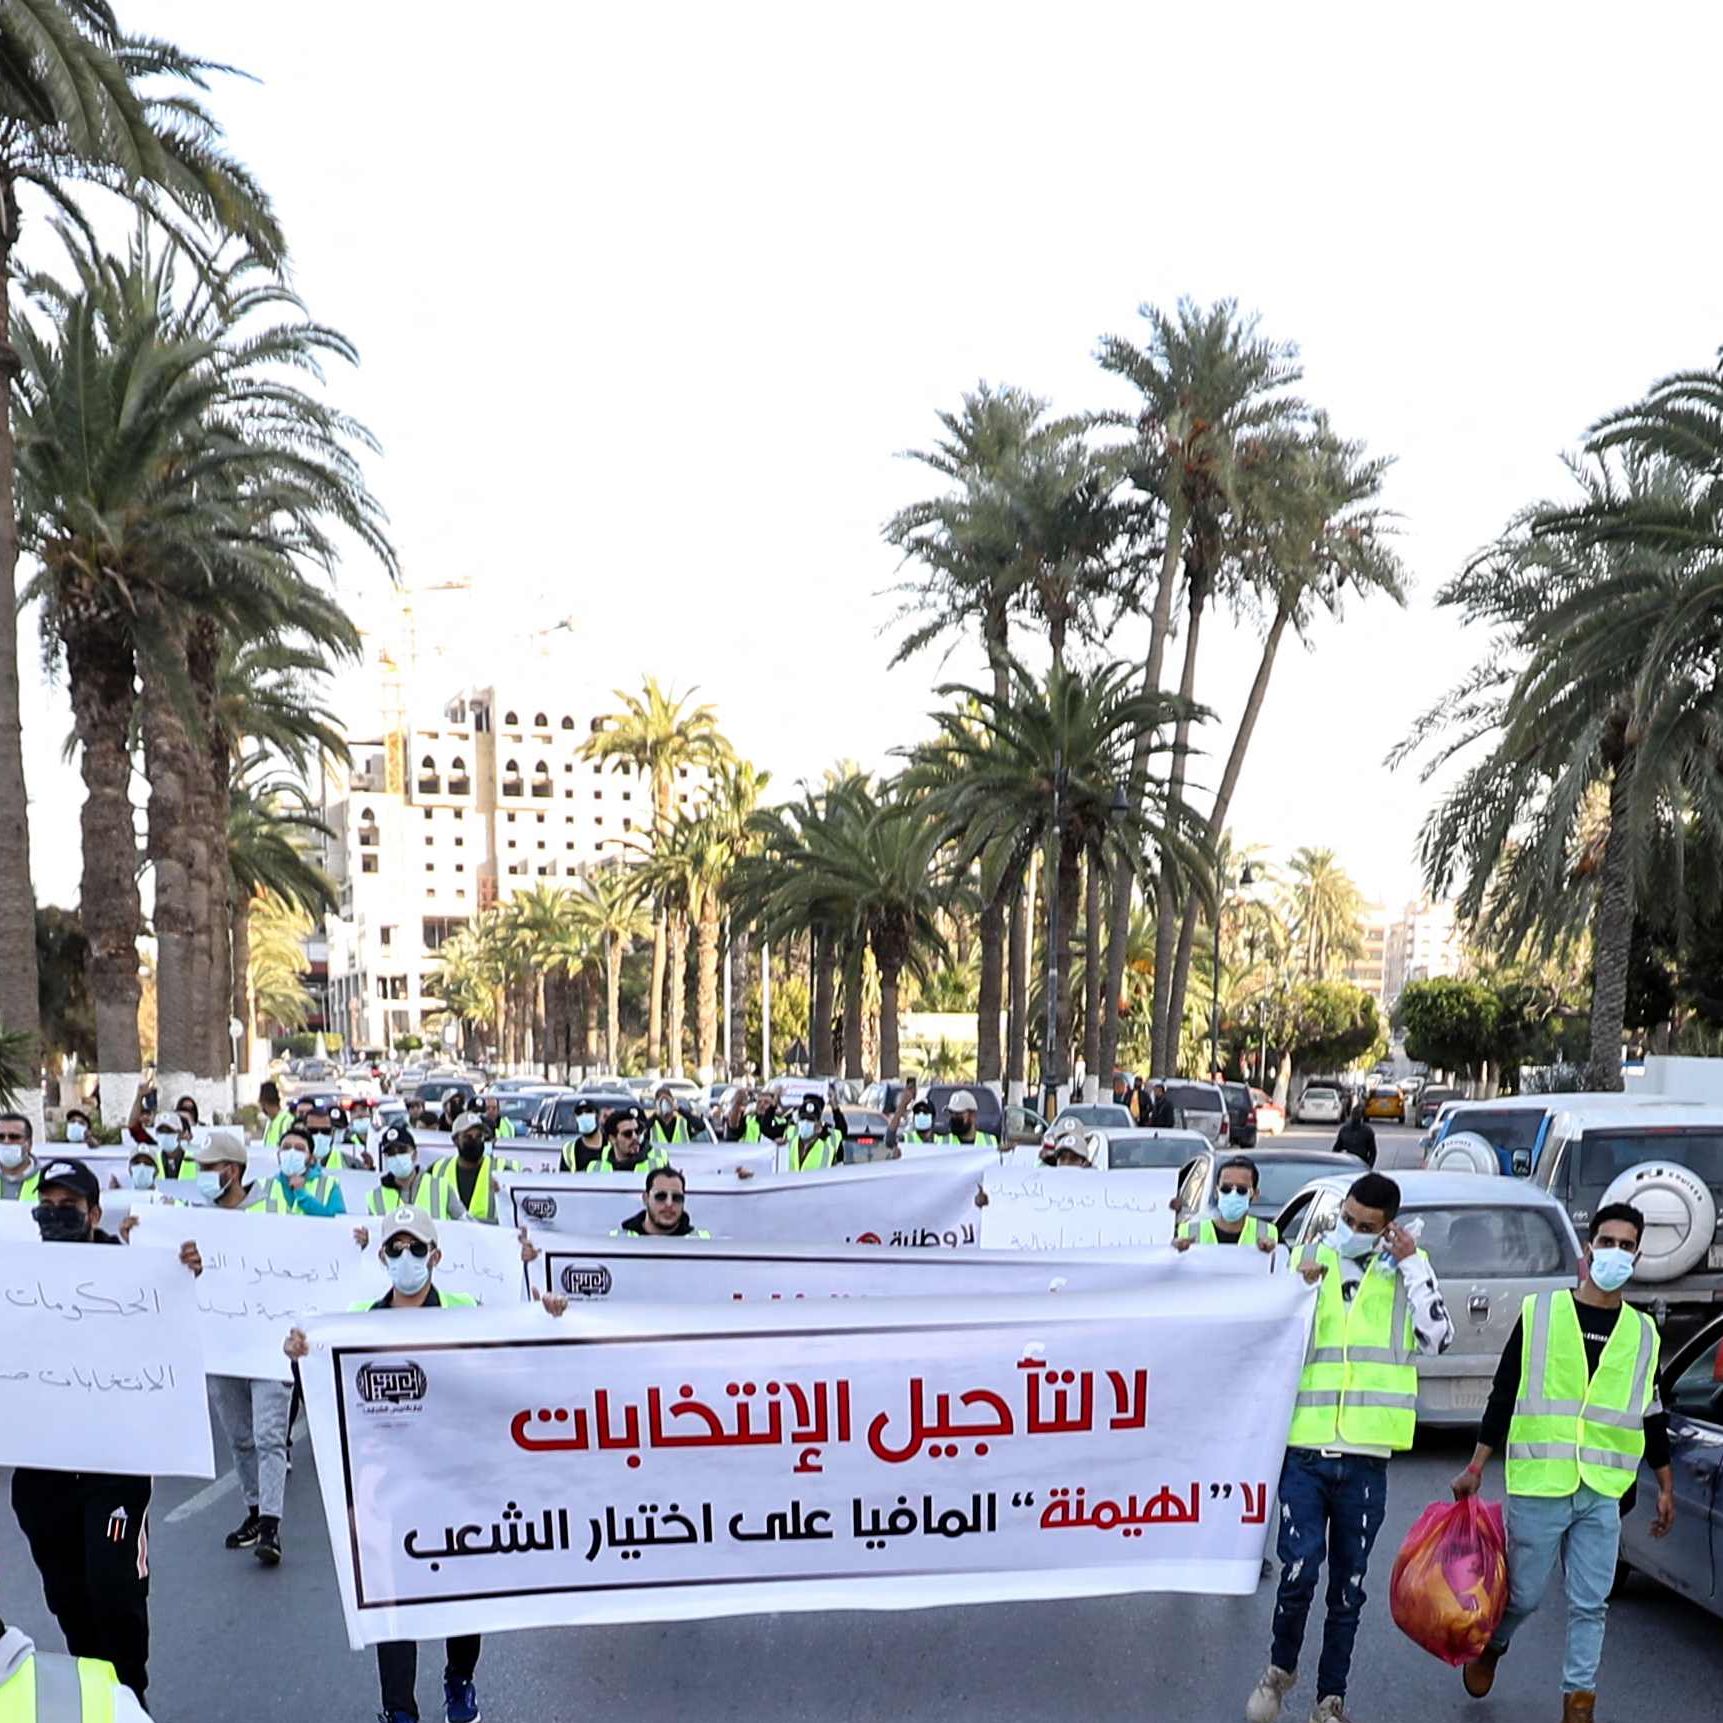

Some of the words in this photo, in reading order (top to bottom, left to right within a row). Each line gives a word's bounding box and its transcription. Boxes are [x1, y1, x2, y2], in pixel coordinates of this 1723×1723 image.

[510, 1379, 851, 1474] الإنتخابات
[1108, 1369, 1148, 1431] لا
[584, 1502, 714, 1563] اختيار
[728, 1500, 834, 1543] على
[851, 1491, 998, 1550] المافيا
[1241, 1481, 1267, 1525] لا
[402, 1500, 571, 1573] الشعب
